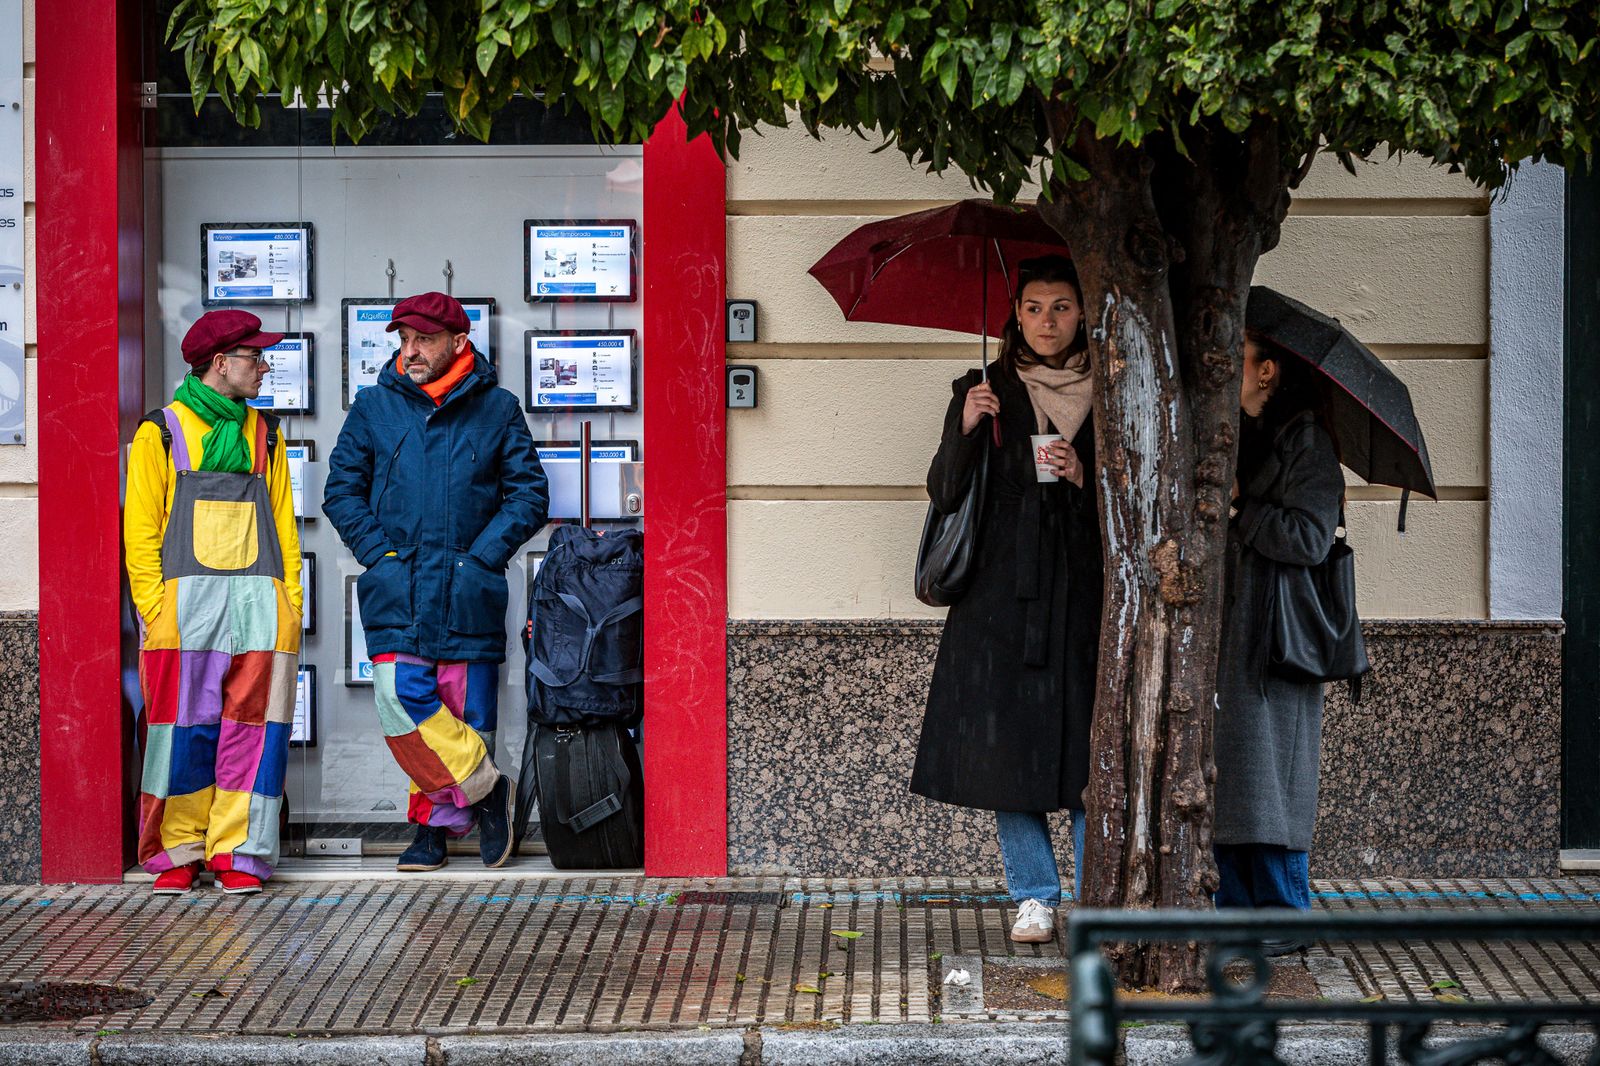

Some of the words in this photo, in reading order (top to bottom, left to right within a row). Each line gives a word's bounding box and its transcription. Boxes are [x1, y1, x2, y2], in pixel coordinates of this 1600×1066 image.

[360, 311, 389, 321] Alquiler
[739, 323, 745, 334] 1
[736, 388, 746, 400] 2
